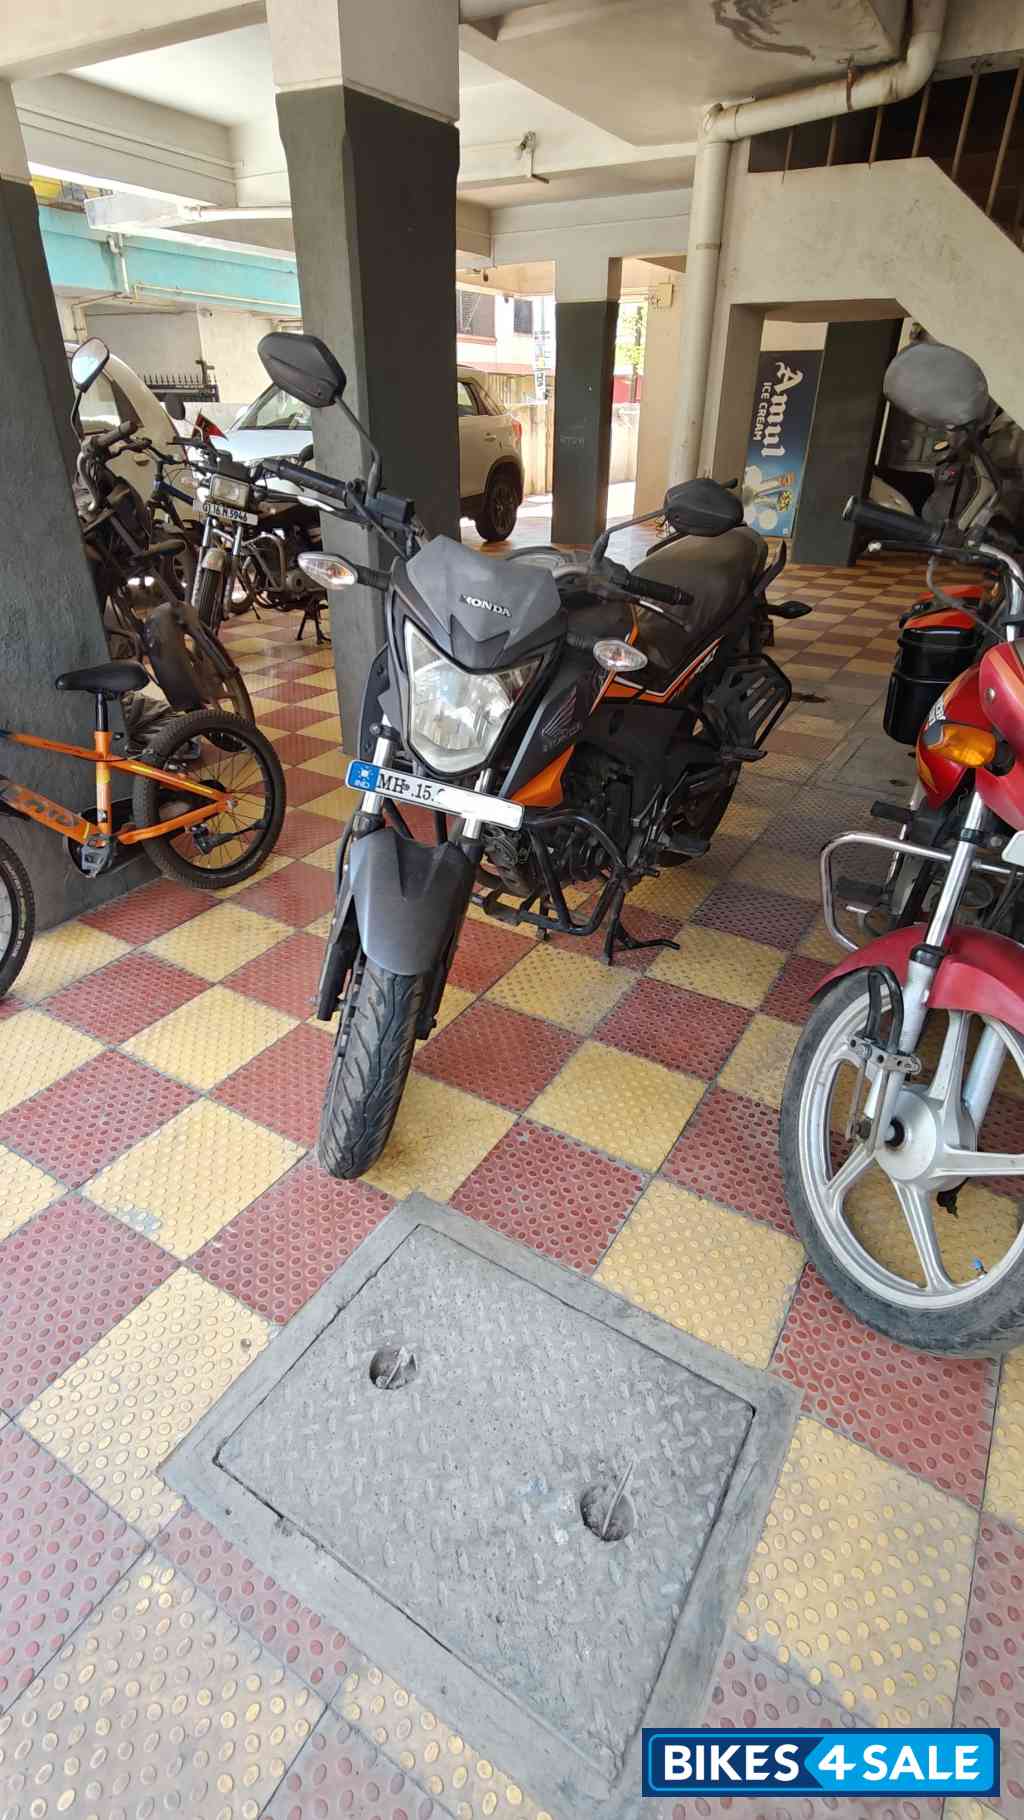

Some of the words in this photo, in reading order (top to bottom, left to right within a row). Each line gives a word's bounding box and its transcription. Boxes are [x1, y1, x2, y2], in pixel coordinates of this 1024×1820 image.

[760, 381, 773, 400] ICE
[761, 361, 804, 458] Amul
[753, 402, 768, 441] CREAM
